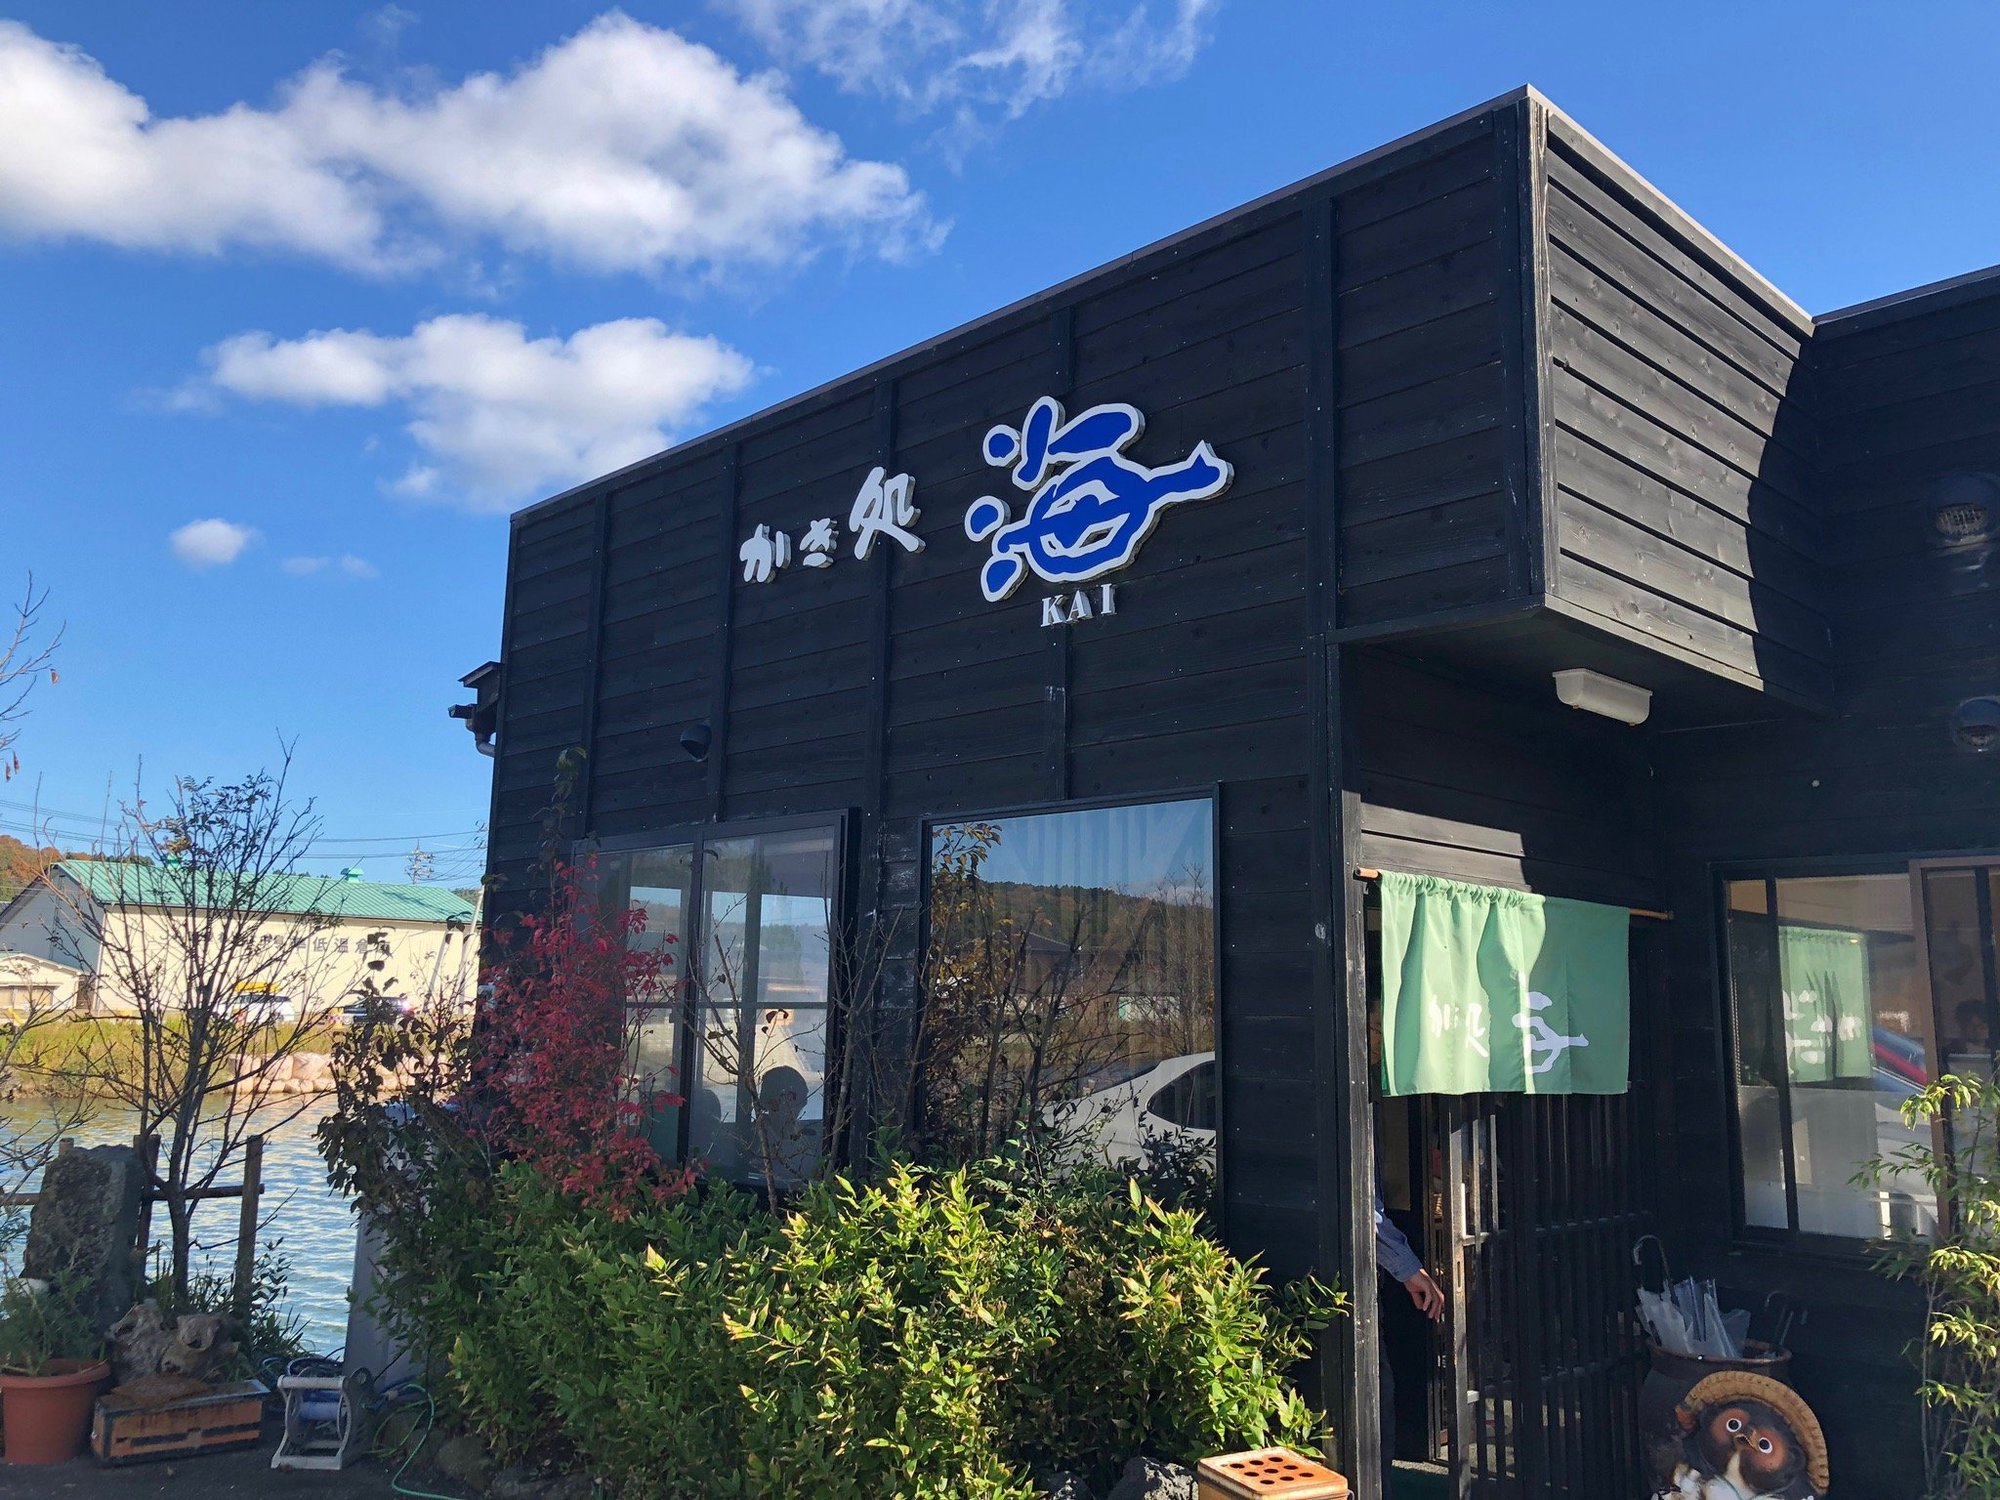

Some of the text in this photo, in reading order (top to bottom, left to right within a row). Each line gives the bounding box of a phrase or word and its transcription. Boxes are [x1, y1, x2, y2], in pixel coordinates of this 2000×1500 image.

[739, 395, 1235, 602] かき処 海
[1040, 585, 1115, 628] KAI
